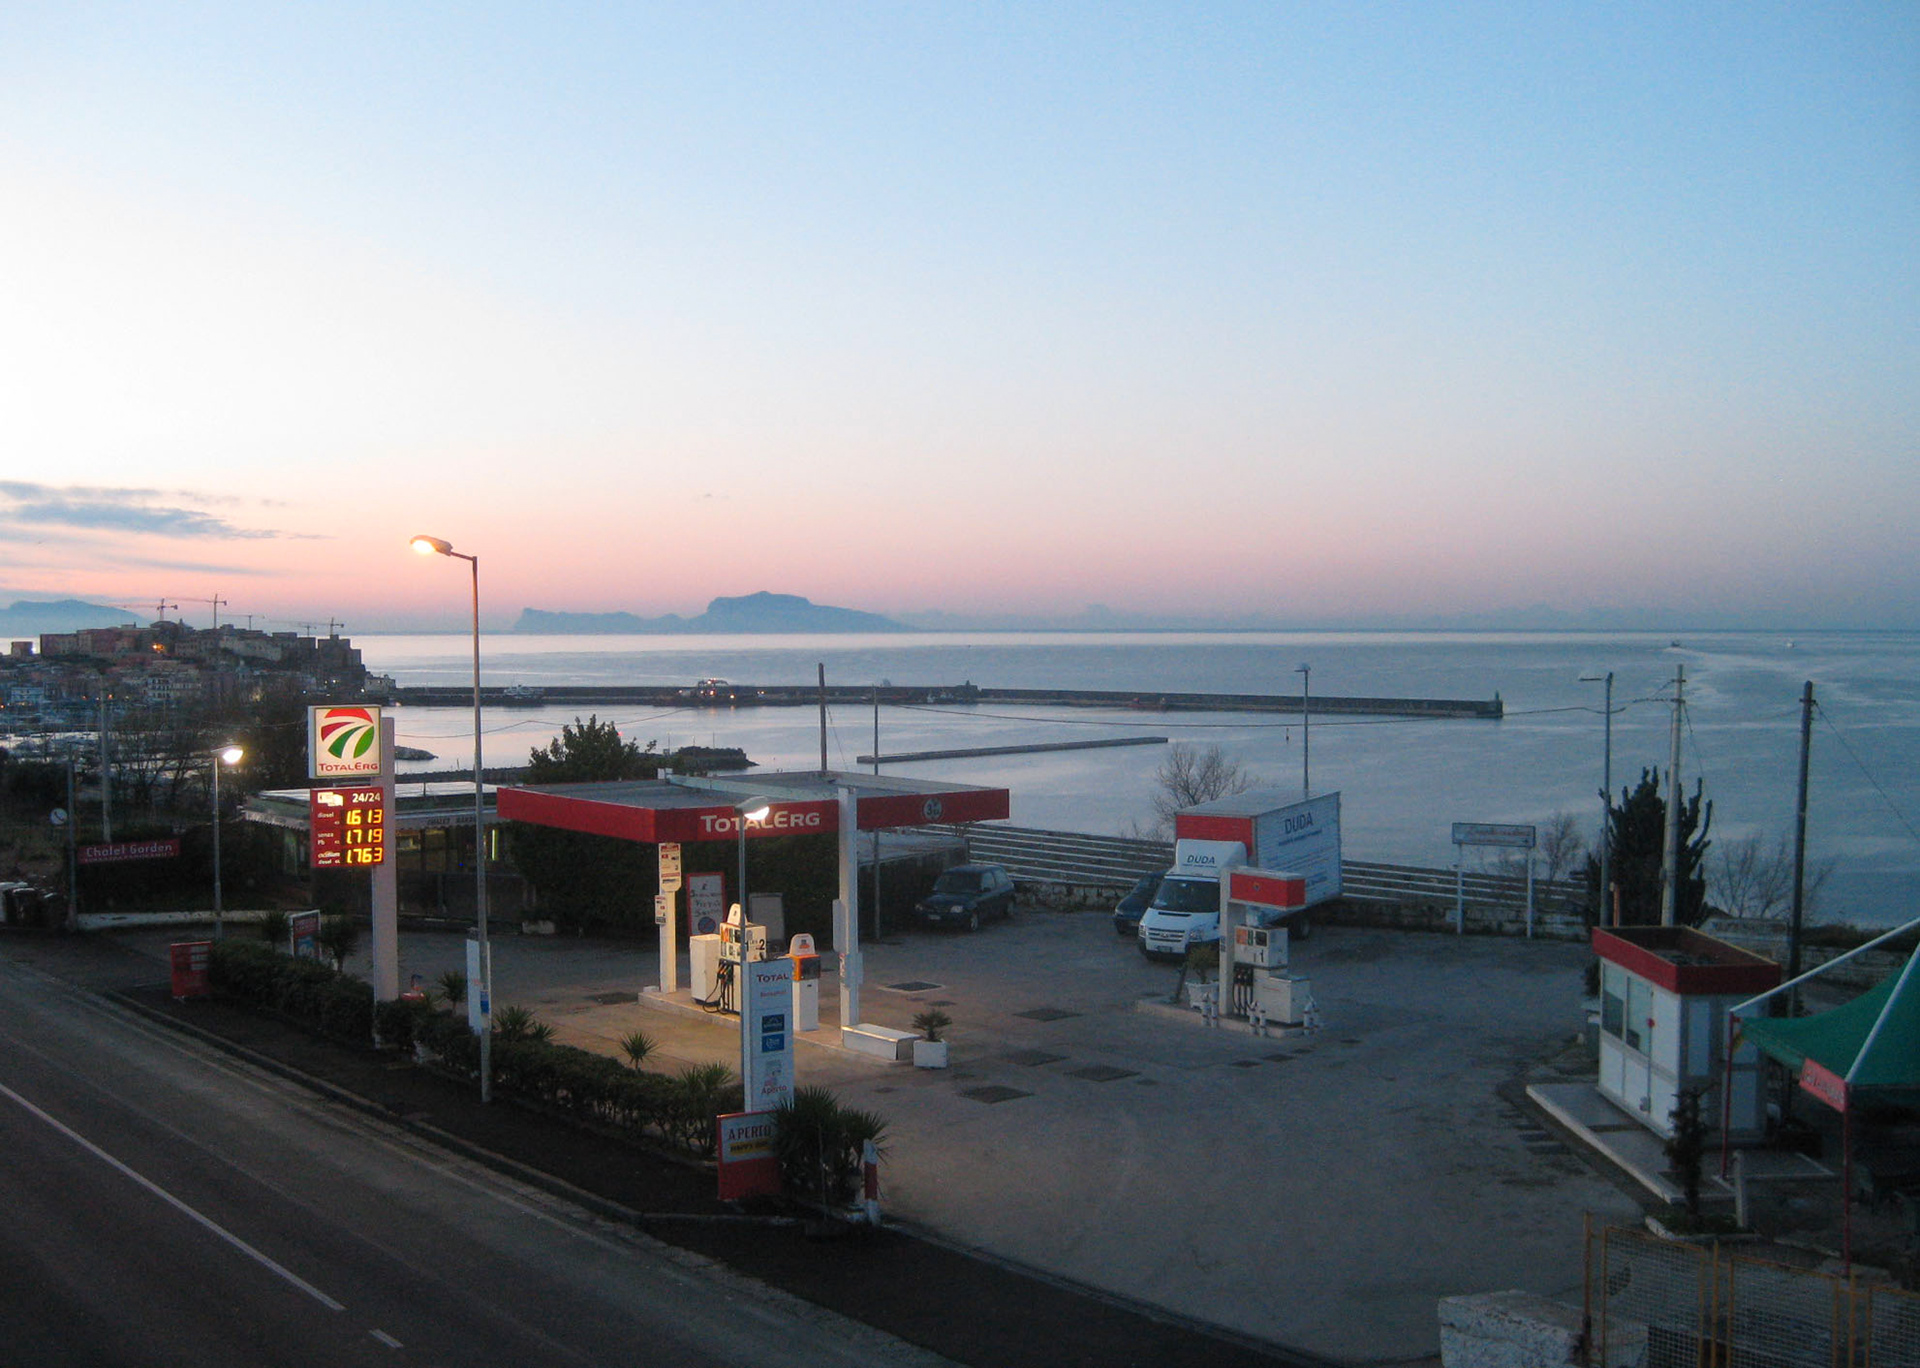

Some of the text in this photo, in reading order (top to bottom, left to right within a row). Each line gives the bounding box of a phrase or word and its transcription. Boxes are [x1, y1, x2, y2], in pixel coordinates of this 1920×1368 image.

[352, 793, 380, 803] 24/24
[1284, 812, 1314, 834] DUDA
[86, 844, 125, 857] Chalet
[130, 842, 172, 854] Garden
[1187, 854, 1215, 864] DUDA
[759, 939, 765, 951] 2
[756, 973, 789, 983] TOTAL
[729, 1125, 771, 1139] APERTO
